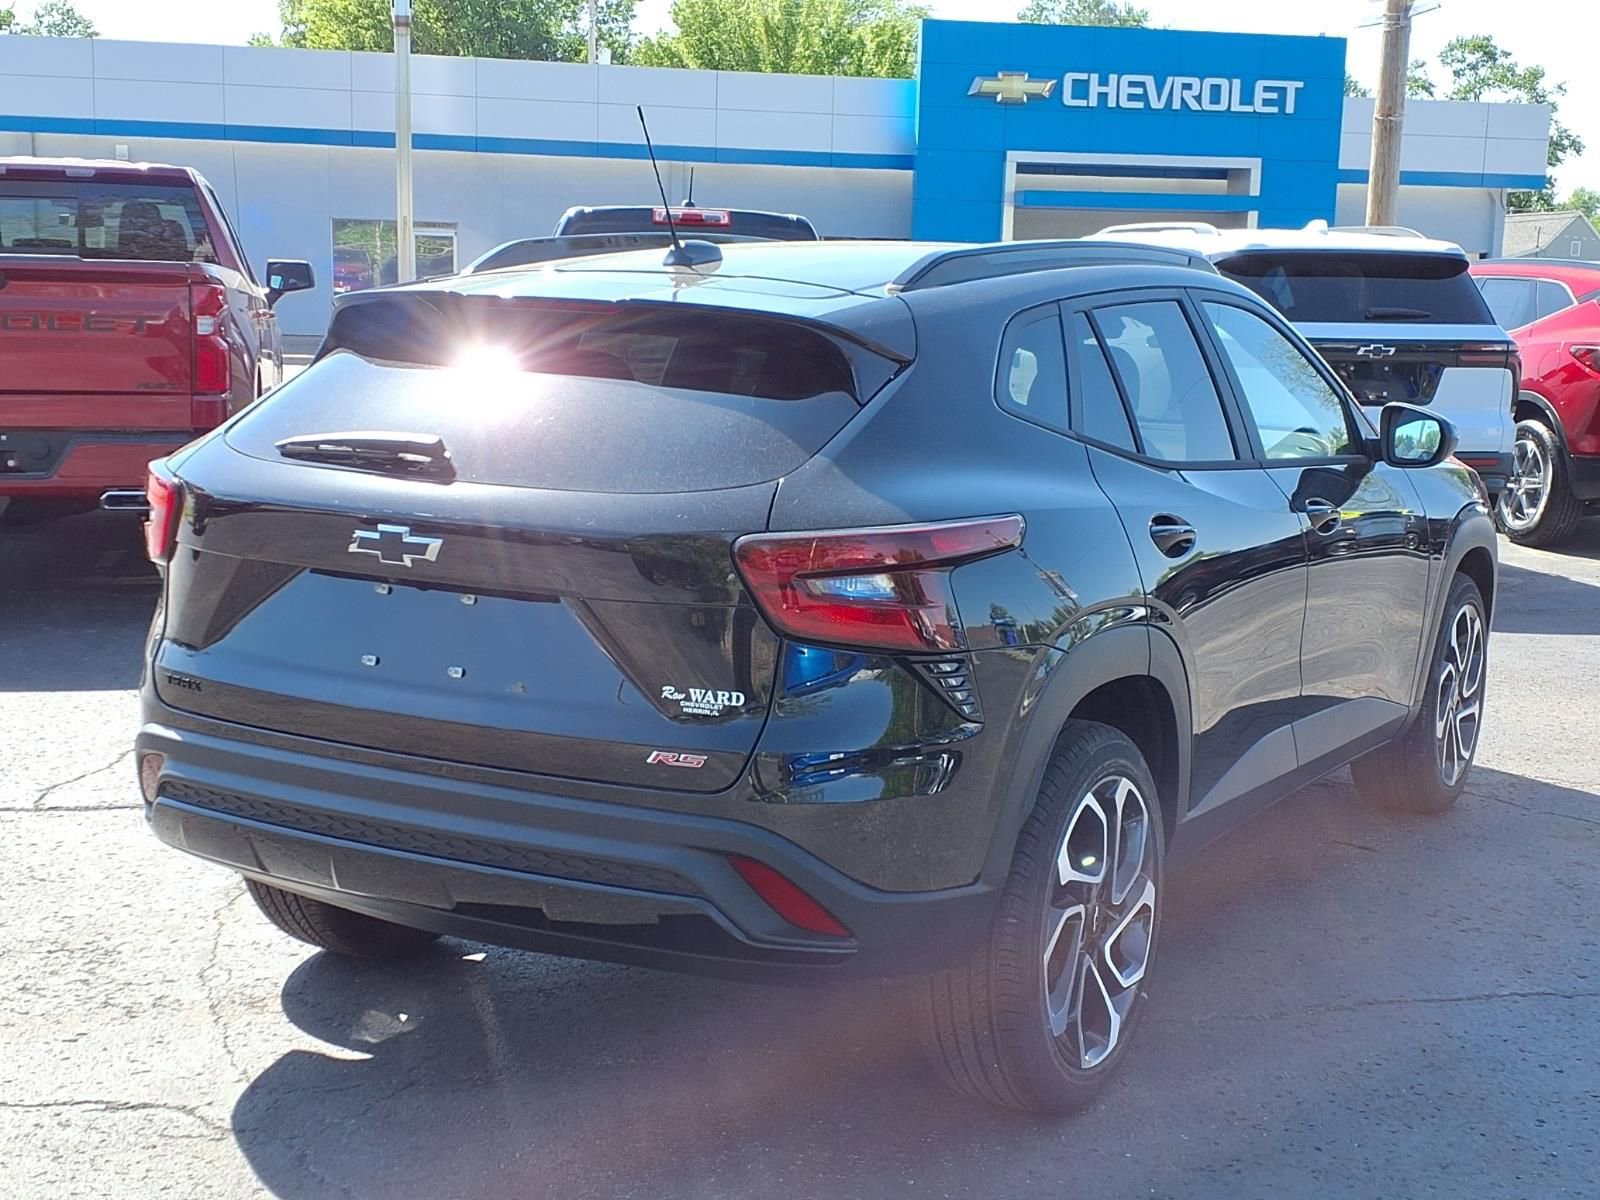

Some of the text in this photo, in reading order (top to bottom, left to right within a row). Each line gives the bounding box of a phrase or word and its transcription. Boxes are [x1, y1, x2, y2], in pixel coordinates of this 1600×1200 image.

[1063, 72, 1304, 114] CHEVROLET
[680, 701, 723, 710] CHEVROLET
[688, 688, 745, 706] WARD
[646, 750, 708, 768] RS
